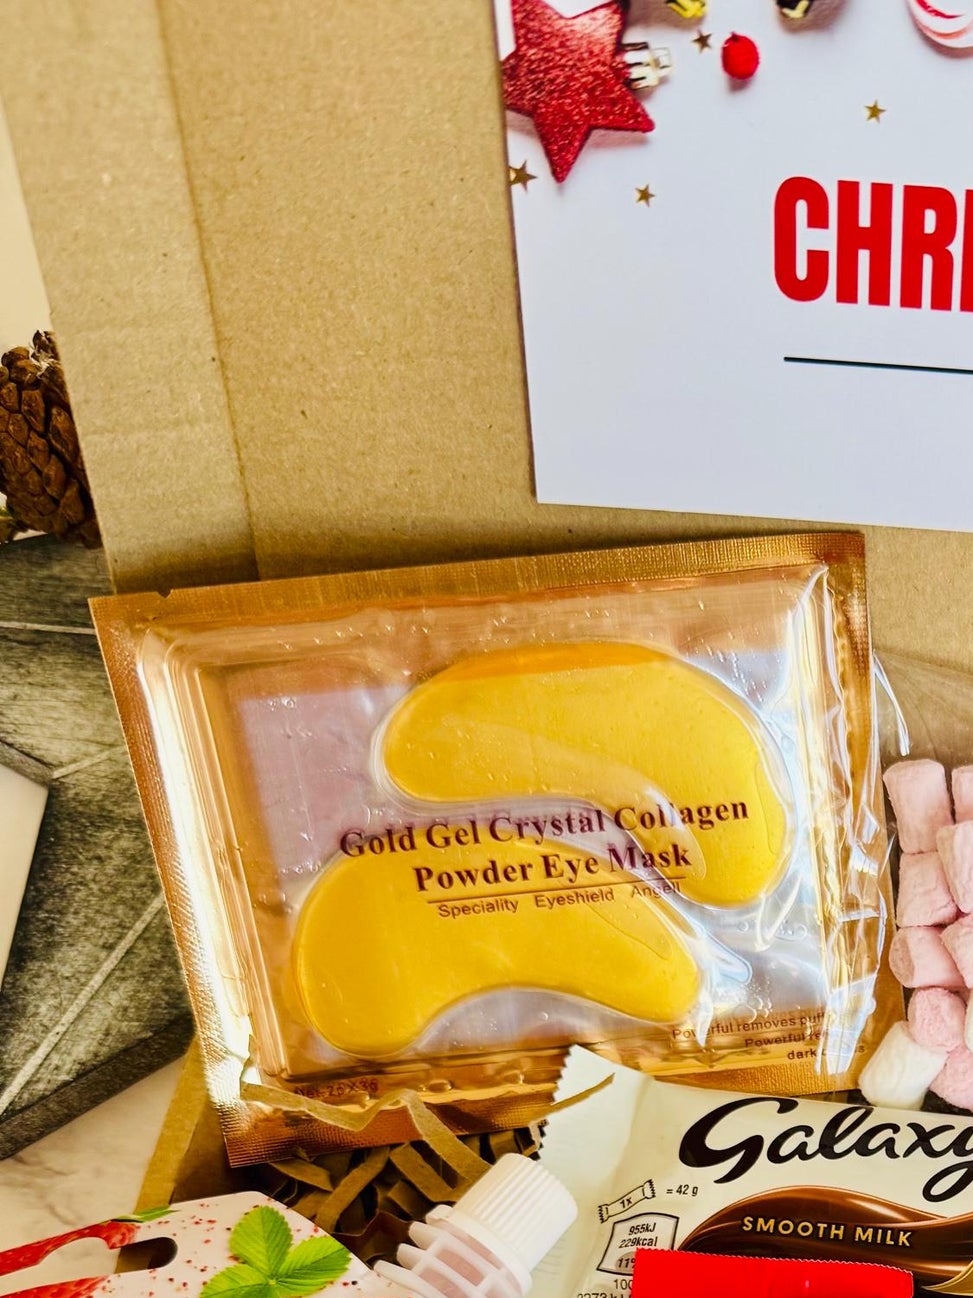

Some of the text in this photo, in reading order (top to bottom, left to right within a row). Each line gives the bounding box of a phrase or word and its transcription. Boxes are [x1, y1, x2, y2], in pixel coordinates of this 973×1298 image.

[340, 825, 418, 859] Gold
[426, 819, 481, 850] Gel
[488, 808, 607, 846] Crystal
[413, 843, 692, 893] Powder Eye Mask
[437, 899, 520, 919] Speciality
[533, 887, 615, 911] Eyeshield
[736, 1017, 797, 1033] removes
[786, 1049, 818, 1061] dark
[619, 1196, 634, 1209] 1x
[675, 1184, 690, 1196] 42
[691, 1185, 699, 1197] g
[628, 1222, 657, 1236] 955kJ
[741, 1215, 914, 1248] SMOOTH MILK
[618, 1236, 659, 1249] 229kcal
